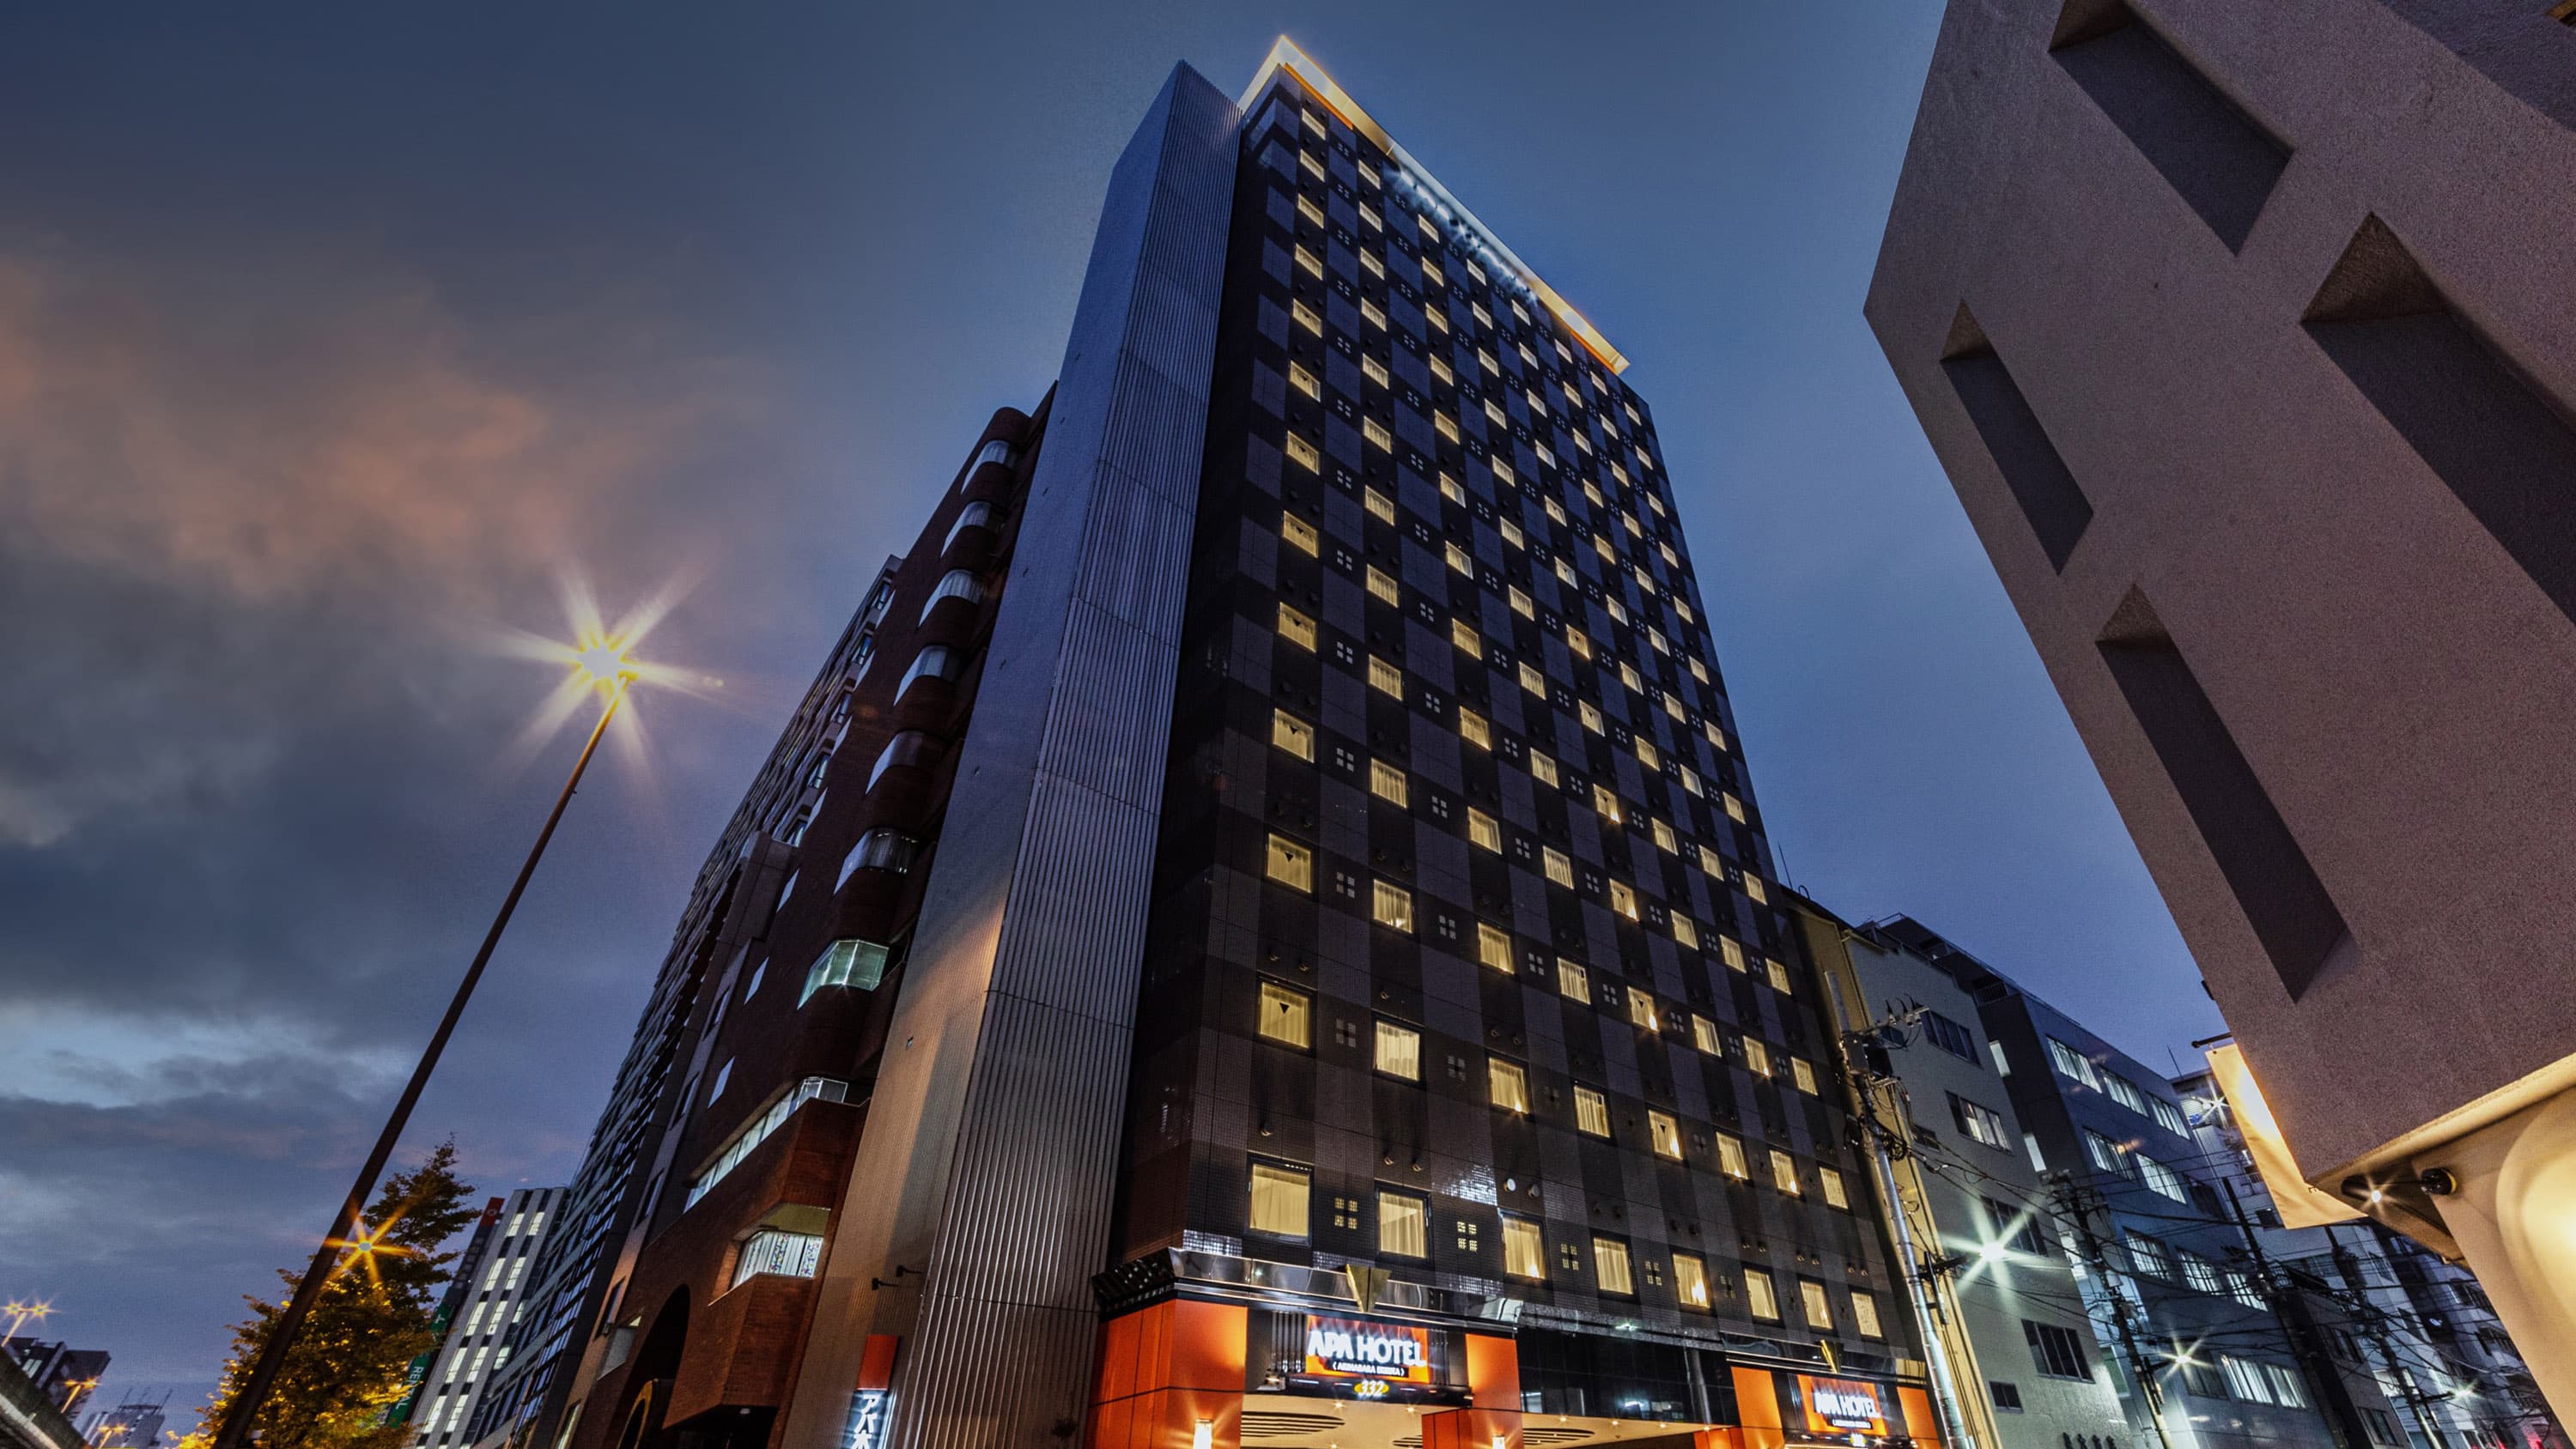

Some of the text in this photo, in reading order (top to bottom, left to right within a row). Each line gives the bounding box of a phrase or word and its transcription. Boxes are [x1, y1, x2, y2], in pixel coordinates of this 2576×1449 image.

[1307, 1330, 1427, 1367] APA HOTEL
[1360, 1379, 1385, 1396] 332
